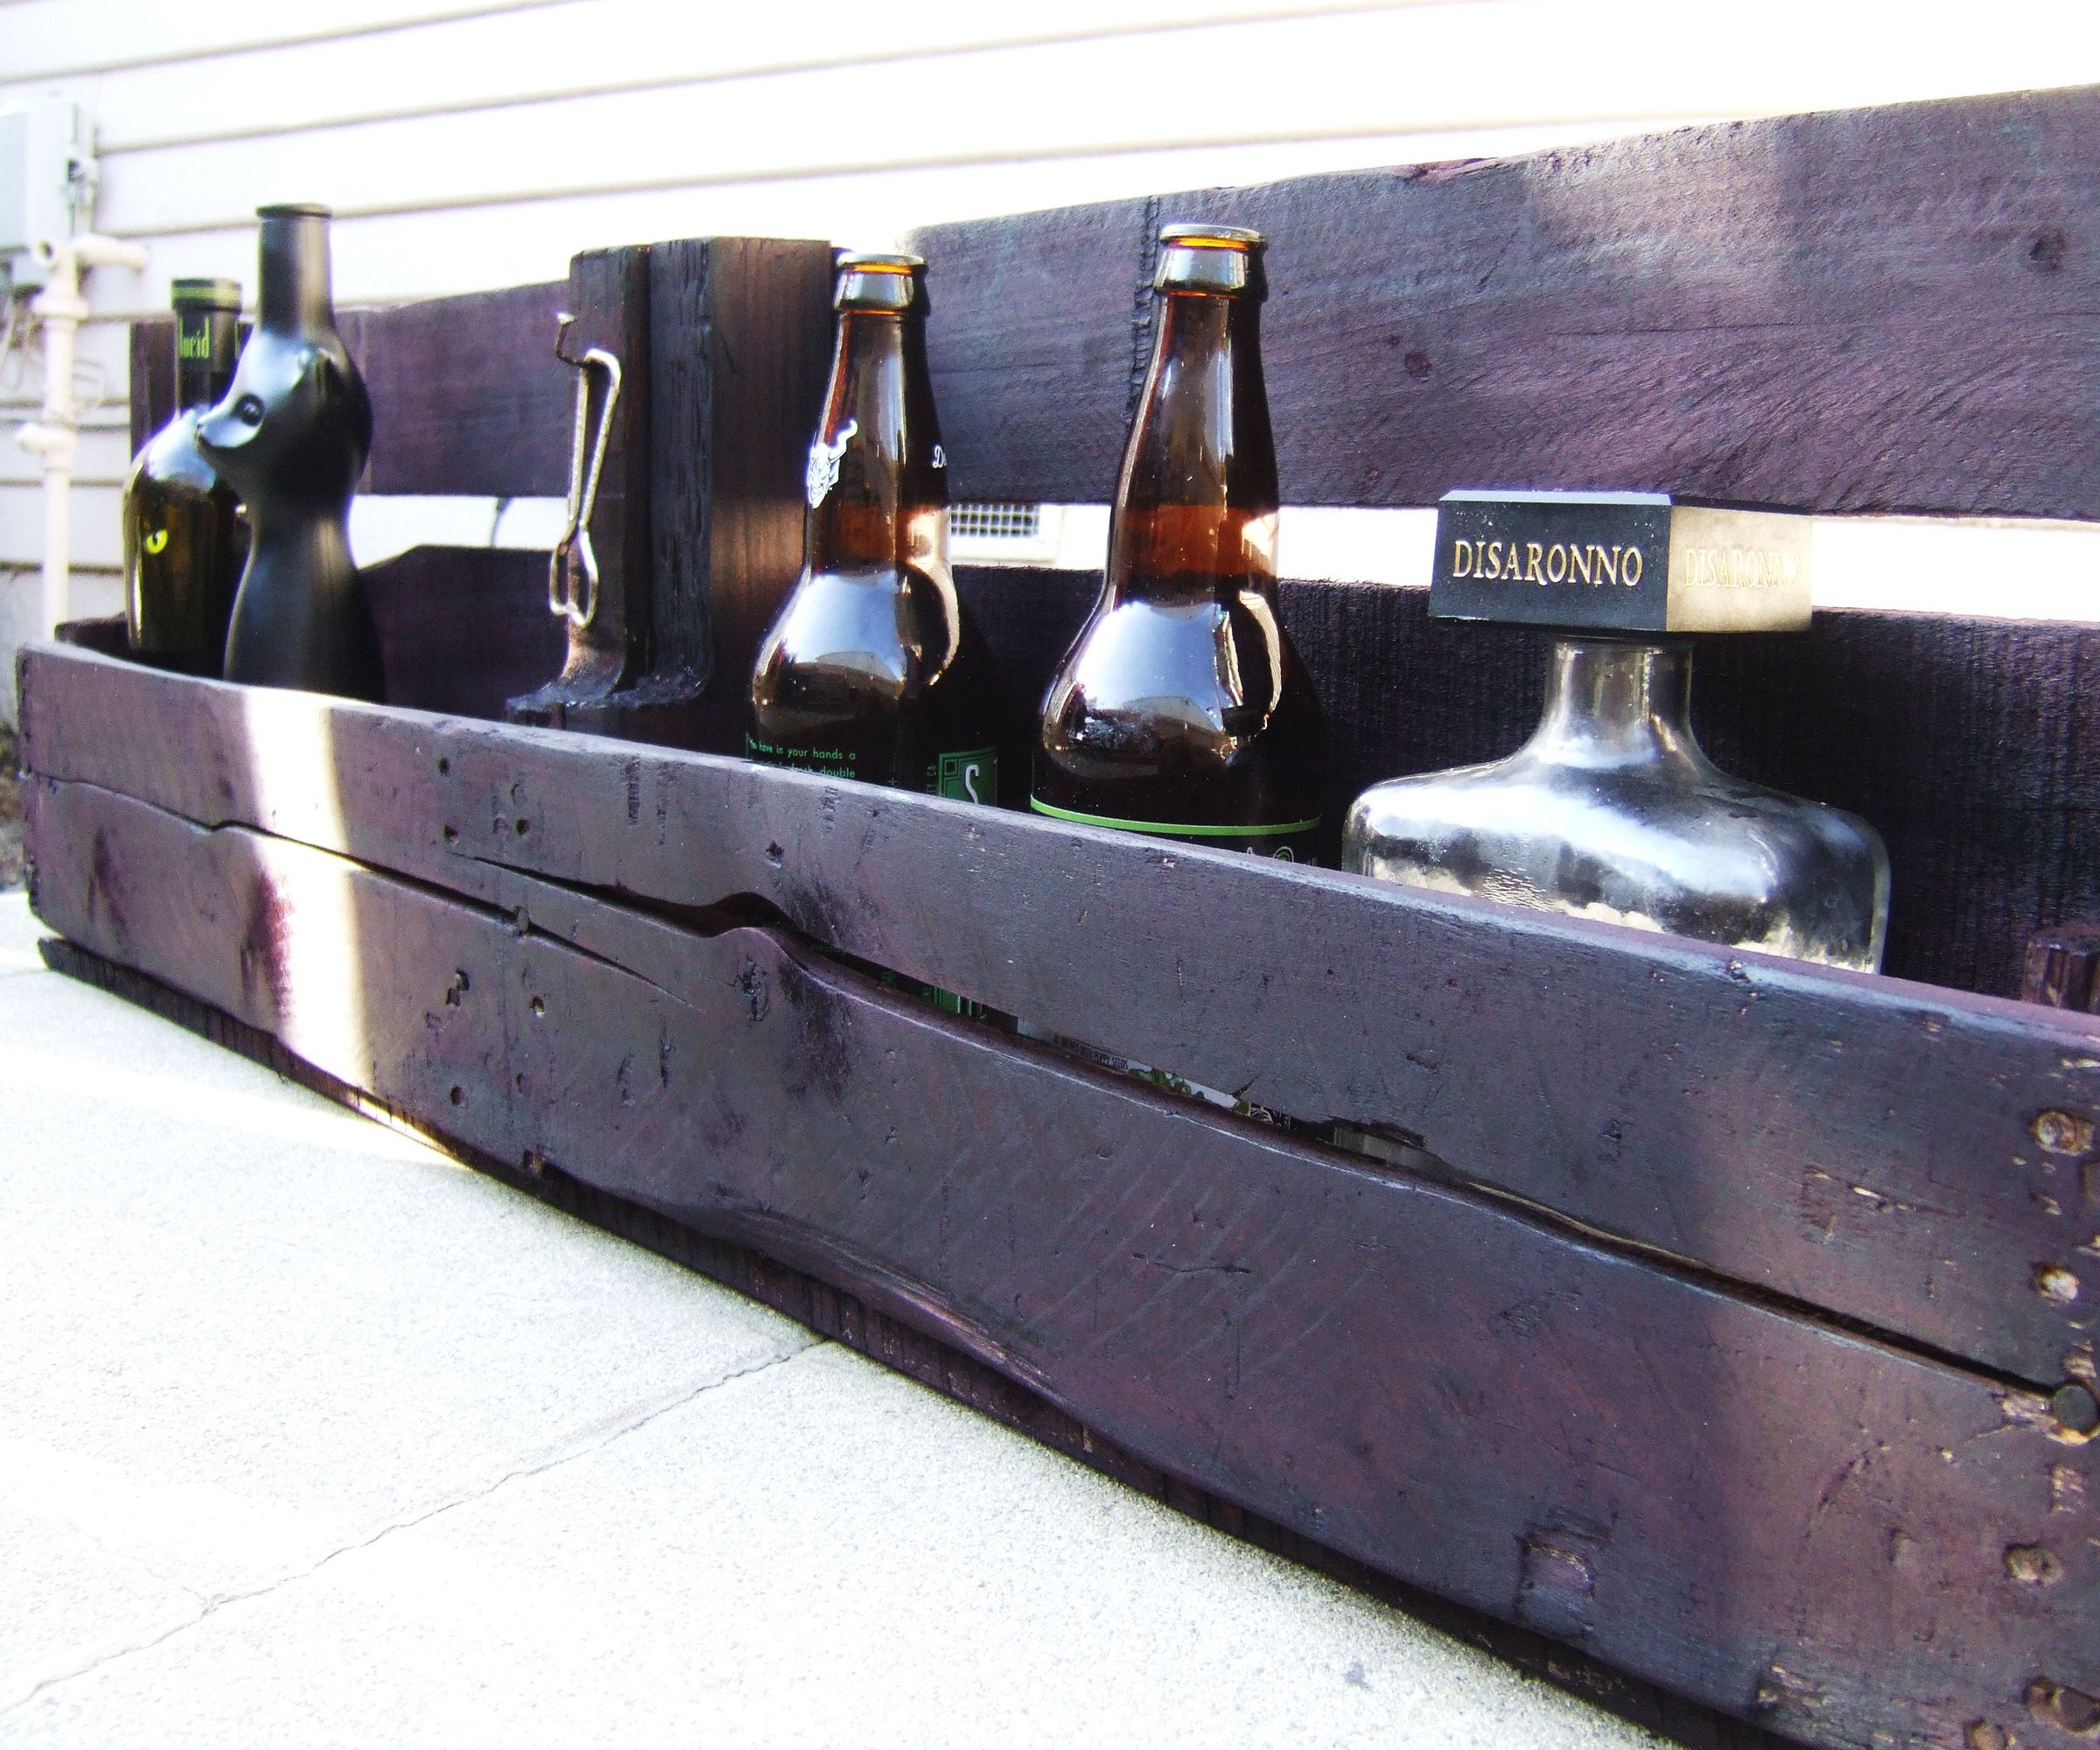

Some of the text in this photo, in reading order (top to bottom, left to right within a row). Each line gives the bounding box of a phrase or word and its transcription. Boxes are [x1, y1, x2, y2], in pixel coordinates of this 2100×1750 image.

[1452, 540, 1643, 588] DISARONNO
[776, 745, 784, 754] in
[788, 748, 808, 759] your
[812, 746, 844, 760] hands
[849, 752, 857, 760] a
